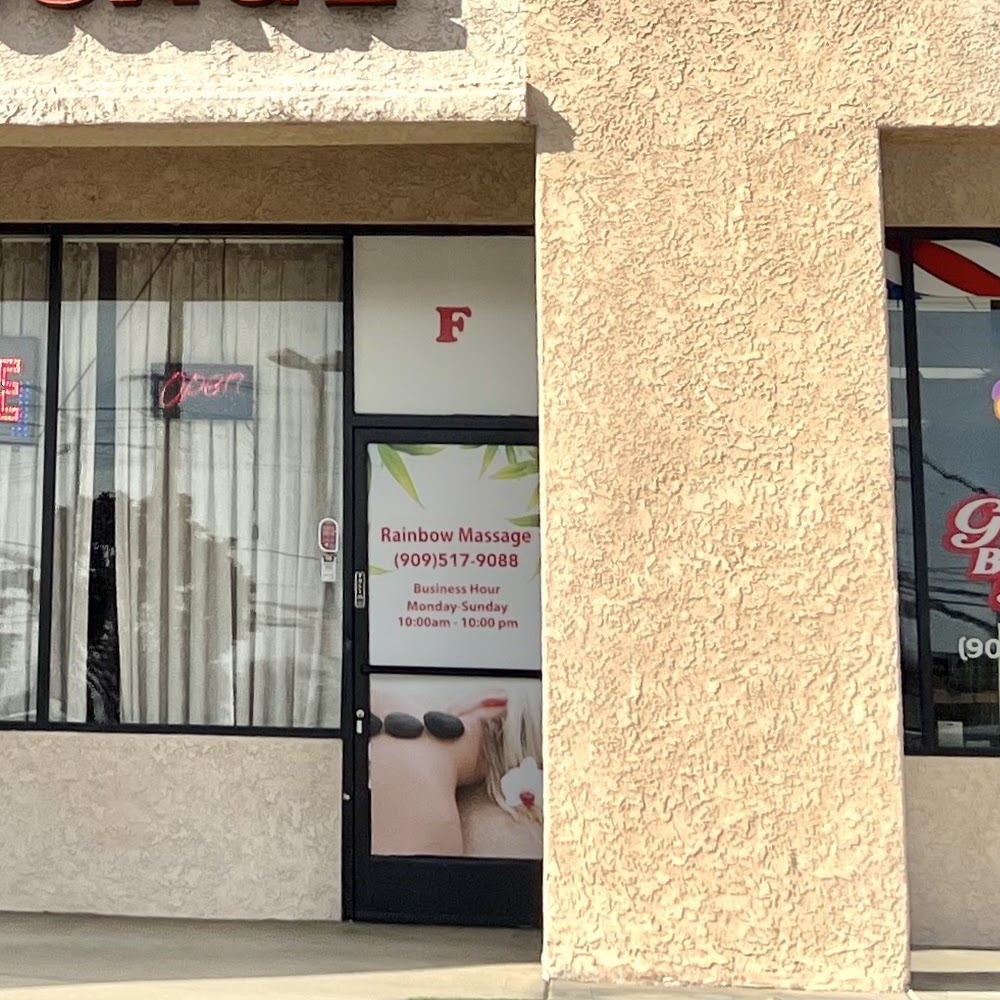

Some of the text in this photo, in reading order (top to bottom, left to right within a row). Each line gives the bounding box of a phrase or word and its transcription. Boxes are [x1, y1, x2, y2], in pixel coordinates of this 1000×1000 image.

[435, 306, 472, 343] F
[381, 527, 531, 547] Rainbow Massage
[394, 553, 519, 569] (909)517-9088
[413, 583, 501, 595] Business Hour
[398, 617, 450, 628] 10:00am
[462, 617, 495, 628] 10:00
[498, 619, 519, 630] pm
